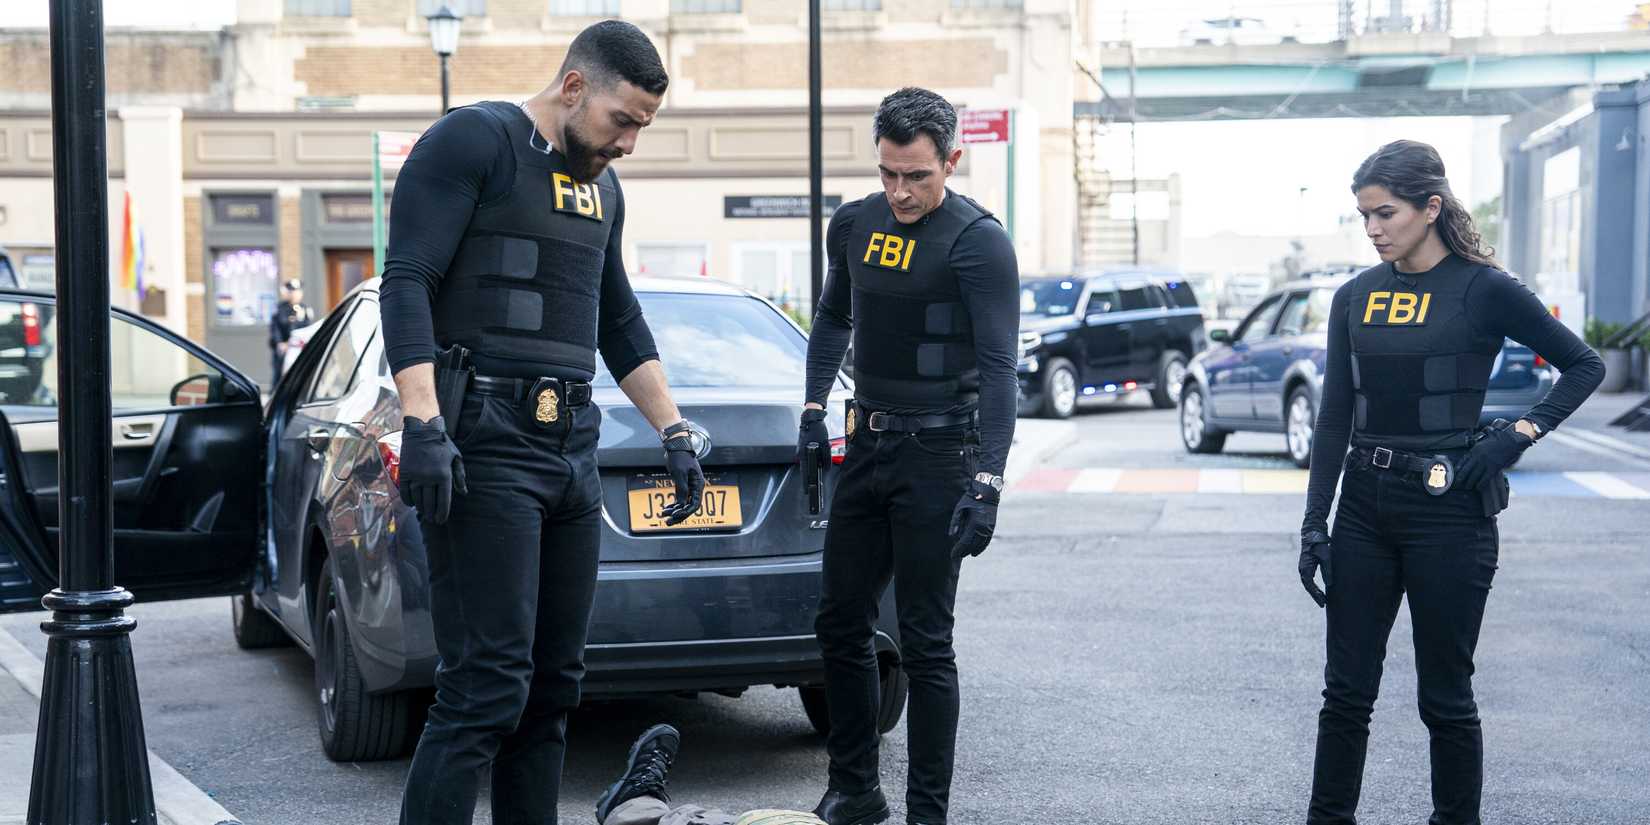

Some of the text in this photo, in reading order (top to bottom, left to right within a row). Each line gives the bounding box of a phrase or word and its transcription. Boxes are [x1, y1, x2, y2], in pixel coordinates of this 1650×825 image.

[553, 172, 603, 220] FBI
[863, 232, 916, 270] FBI
[1363, 291, 1432, 324] FBI
